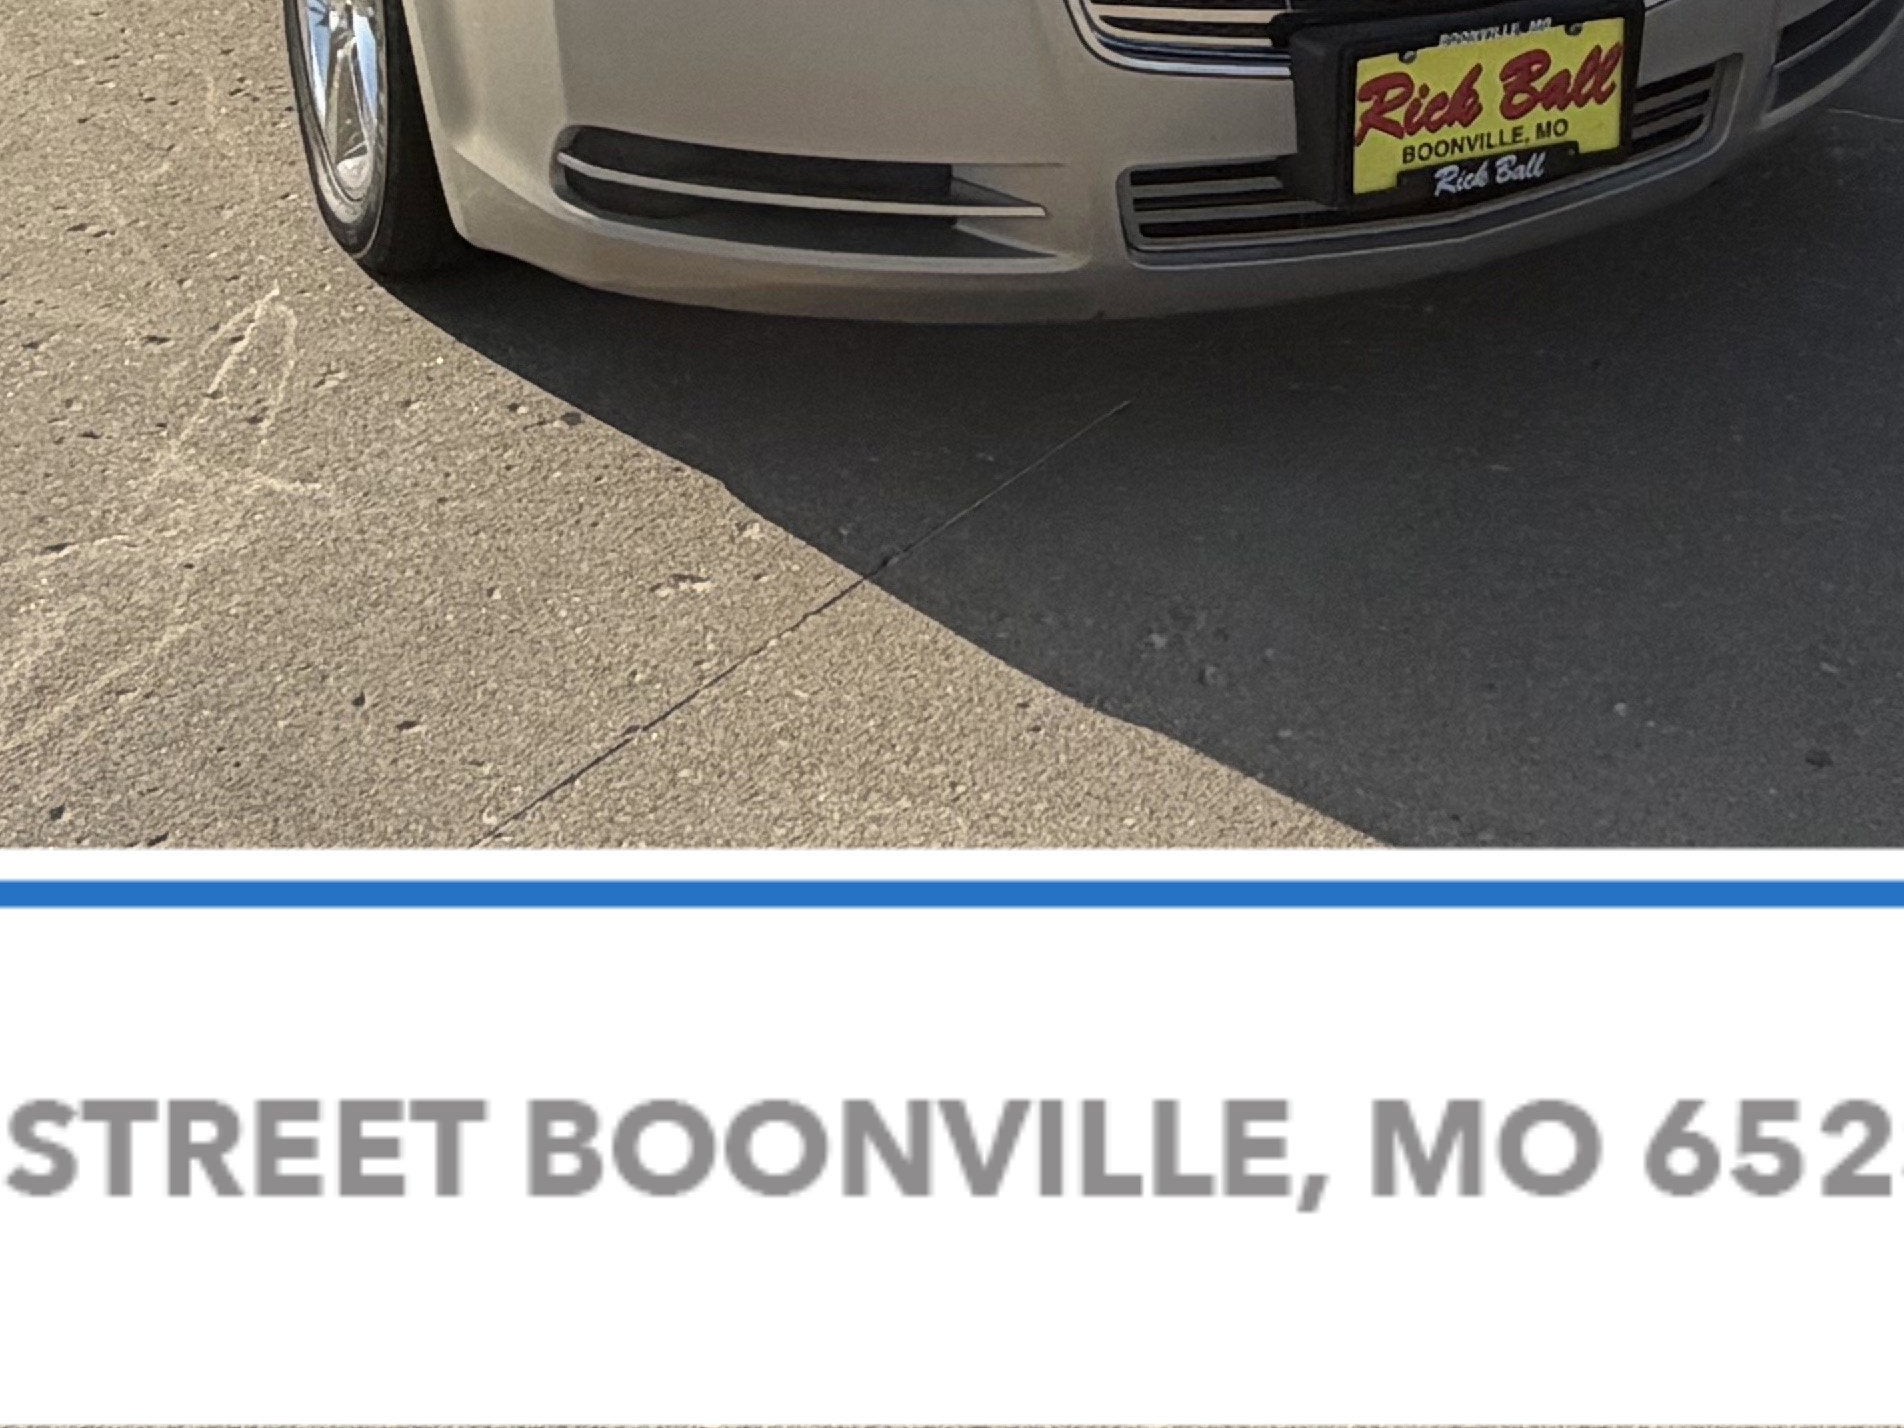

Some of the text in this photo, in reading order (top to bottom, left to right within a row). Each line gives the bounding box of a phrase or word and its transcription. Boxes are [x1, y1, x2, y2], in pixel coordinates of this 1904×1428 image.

[1354, 42, 1623, 147] Rick Ball
[1402, 118, 1570, 165] BOONVILLE, MO
[1433, 152, 1547, 197] Rick Ball
